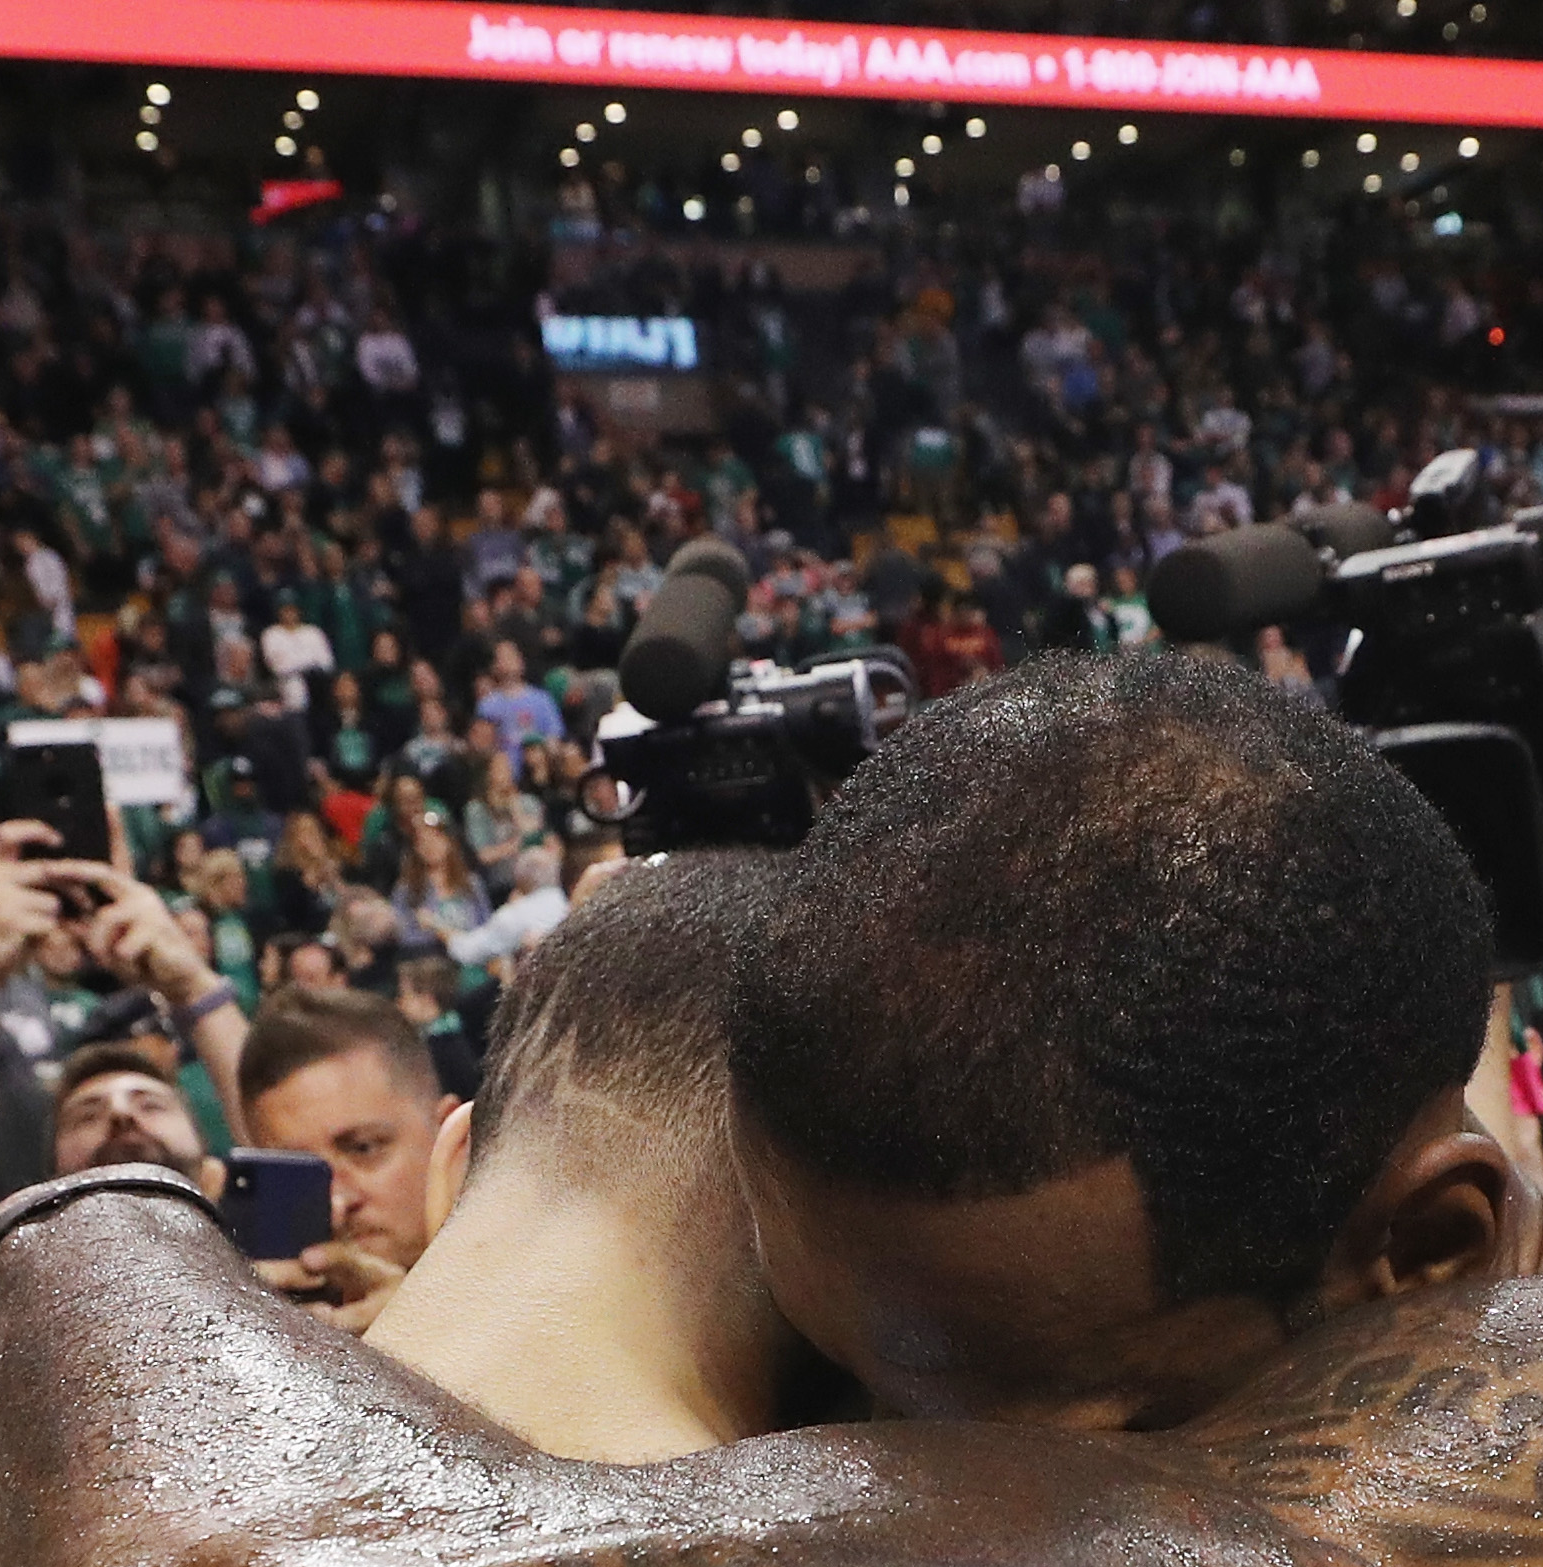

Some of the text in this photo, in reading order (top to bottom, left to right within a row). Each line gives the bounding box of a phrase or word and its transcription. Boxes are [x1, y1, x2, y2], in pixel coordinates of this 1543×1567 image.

[467, 14, 554, 64] Join
[557, 28, 605, 67] or
[608, 31, 734, 75] renew
[737, 31, 860, 88] today!
[864, 36, 1032, 89] AAA.com
